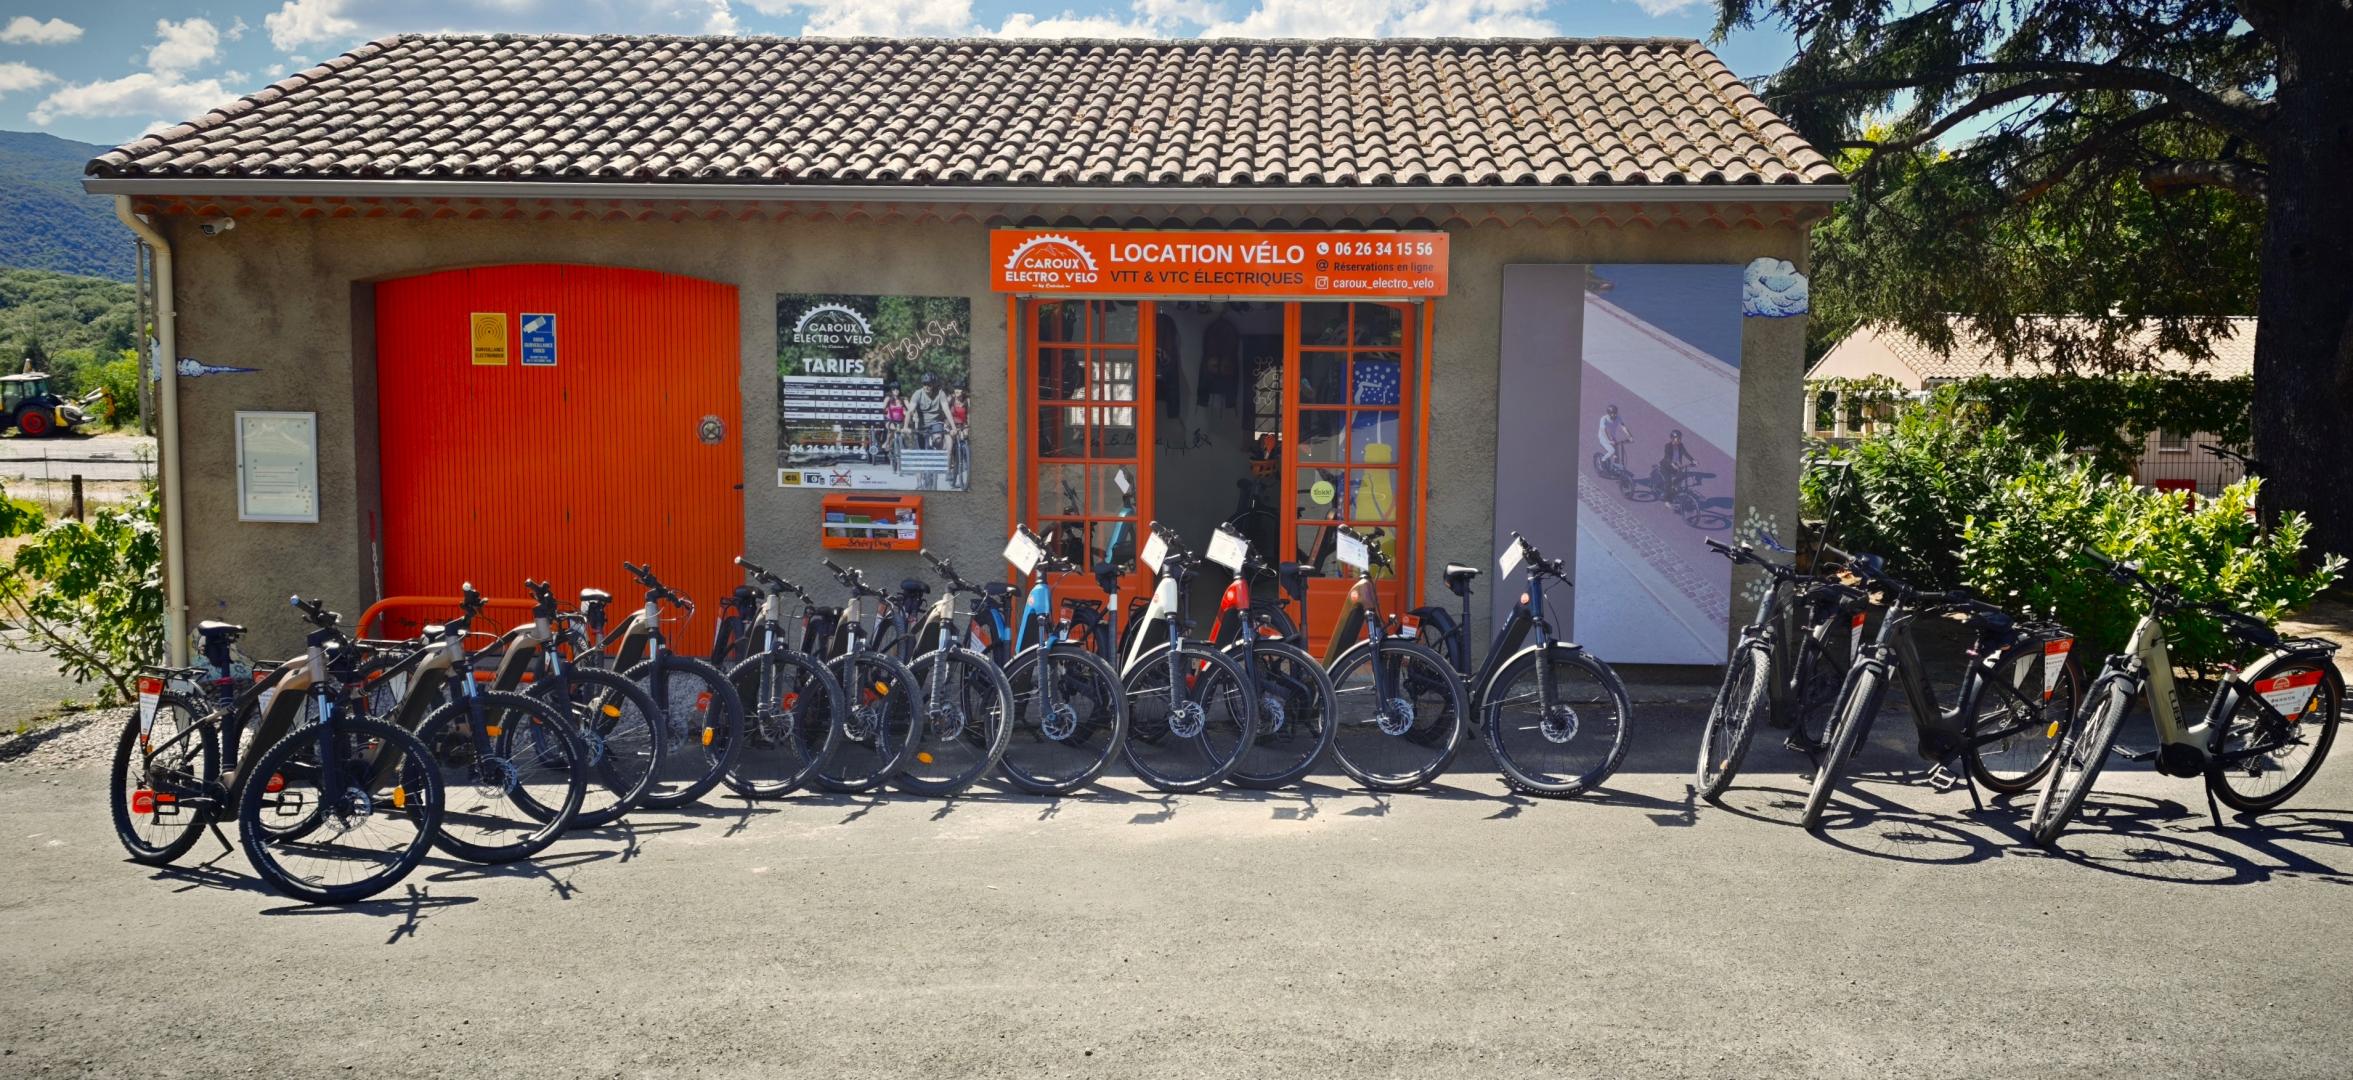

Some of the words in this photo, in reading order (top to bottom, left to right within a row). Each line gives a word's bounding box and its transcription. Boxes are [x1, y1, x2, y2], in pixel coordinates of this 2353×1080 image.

[1110, 243, 1233, 264] LOCATION
[1239, 240, 1305, 264] VÉLO
[1335, 242, 1352, 256] 06
[1355, 242, 1372, 256] 26
[1375, 242, 1392, 256] 34
[1396, 242, 1412, 256] 15
[1416, 242, 1433, 256] 56
[1024, 258, 1080, 269] CAROUX
[1334, 262, 1394, 272] Réservations
[1397, 264, 1408, 272] en
[1411, 262, 1434, 273] ligne
[1005, 271, 1059, 282] ELECTRO
[1065, 272, 1098, 283] VELO
[1110, 270, 1139, 283] VTT
[1143, 271, 1154, 283] &
[1159, 271, 1189, 284] VTC
[1194, 269, 1304, 287] ÉLECTRIQUES
[1333, 277, 1434, 289] caroux_electro_velo
[809, 323, 857, 333] CAROUX
[927, 320, 960, 346] Shop
[793, 333, 840, 344] ELECTRO
[844, 335, 873, 344] VELO
[802, 358, 865, 374] TARIFS
[790, 444, 804, 453] 06
[807, 444, 820, 453] 26
[822, 445, 835, 454] 34
[839, 445, 850, 454] 15
[852, 446, 866, 454] 56
